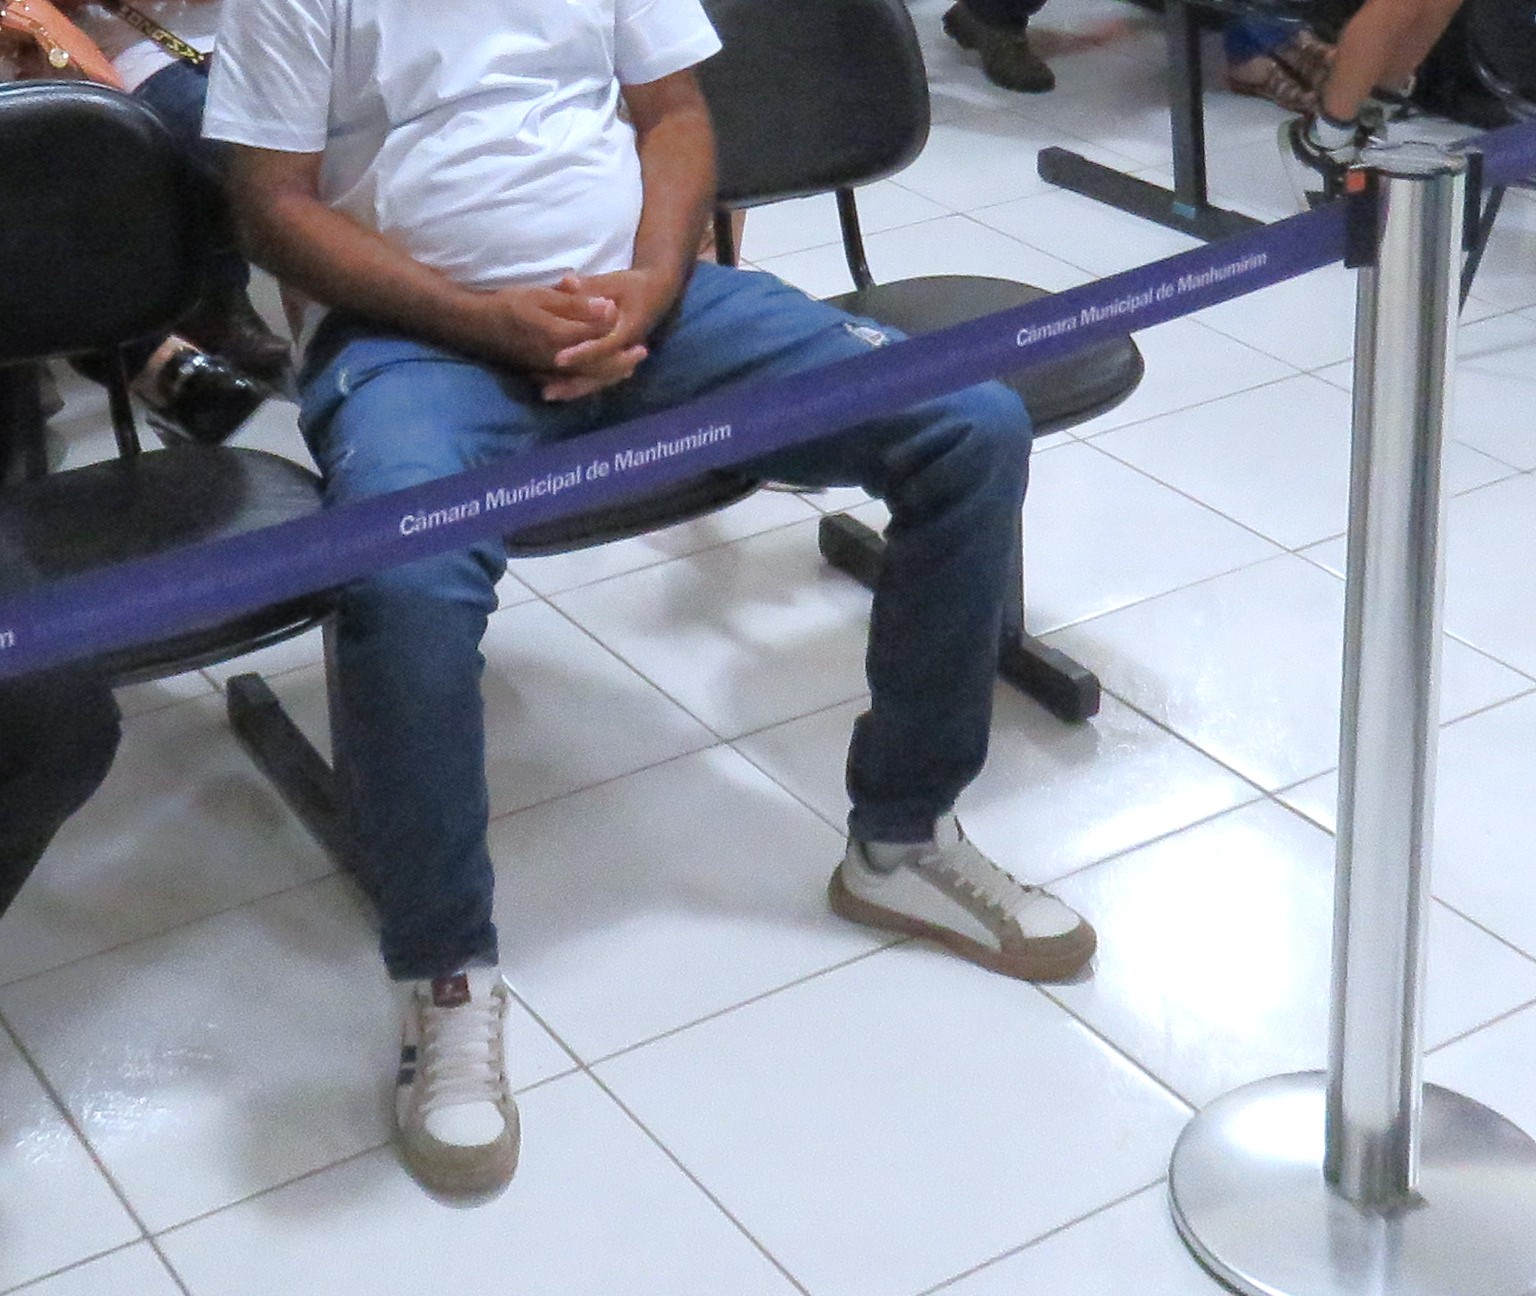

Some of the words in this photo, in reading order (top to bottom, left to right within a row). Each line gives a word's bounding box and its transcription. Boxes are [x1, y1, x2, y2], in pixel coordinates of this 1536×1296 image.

[1016, 318, 1078, 347] Câmara
[1080, 287, 1154, 327] Municipal
[1156, 282, 1175, 301] de
[1177, 251, 1268, 294] Manhumirim
[399, 498, 481, 536] Câmara
[484, 466, 582, 512] Municipal
[586, 458, 611, 482] de
[614, 422, 733, 472] Manhumirim
